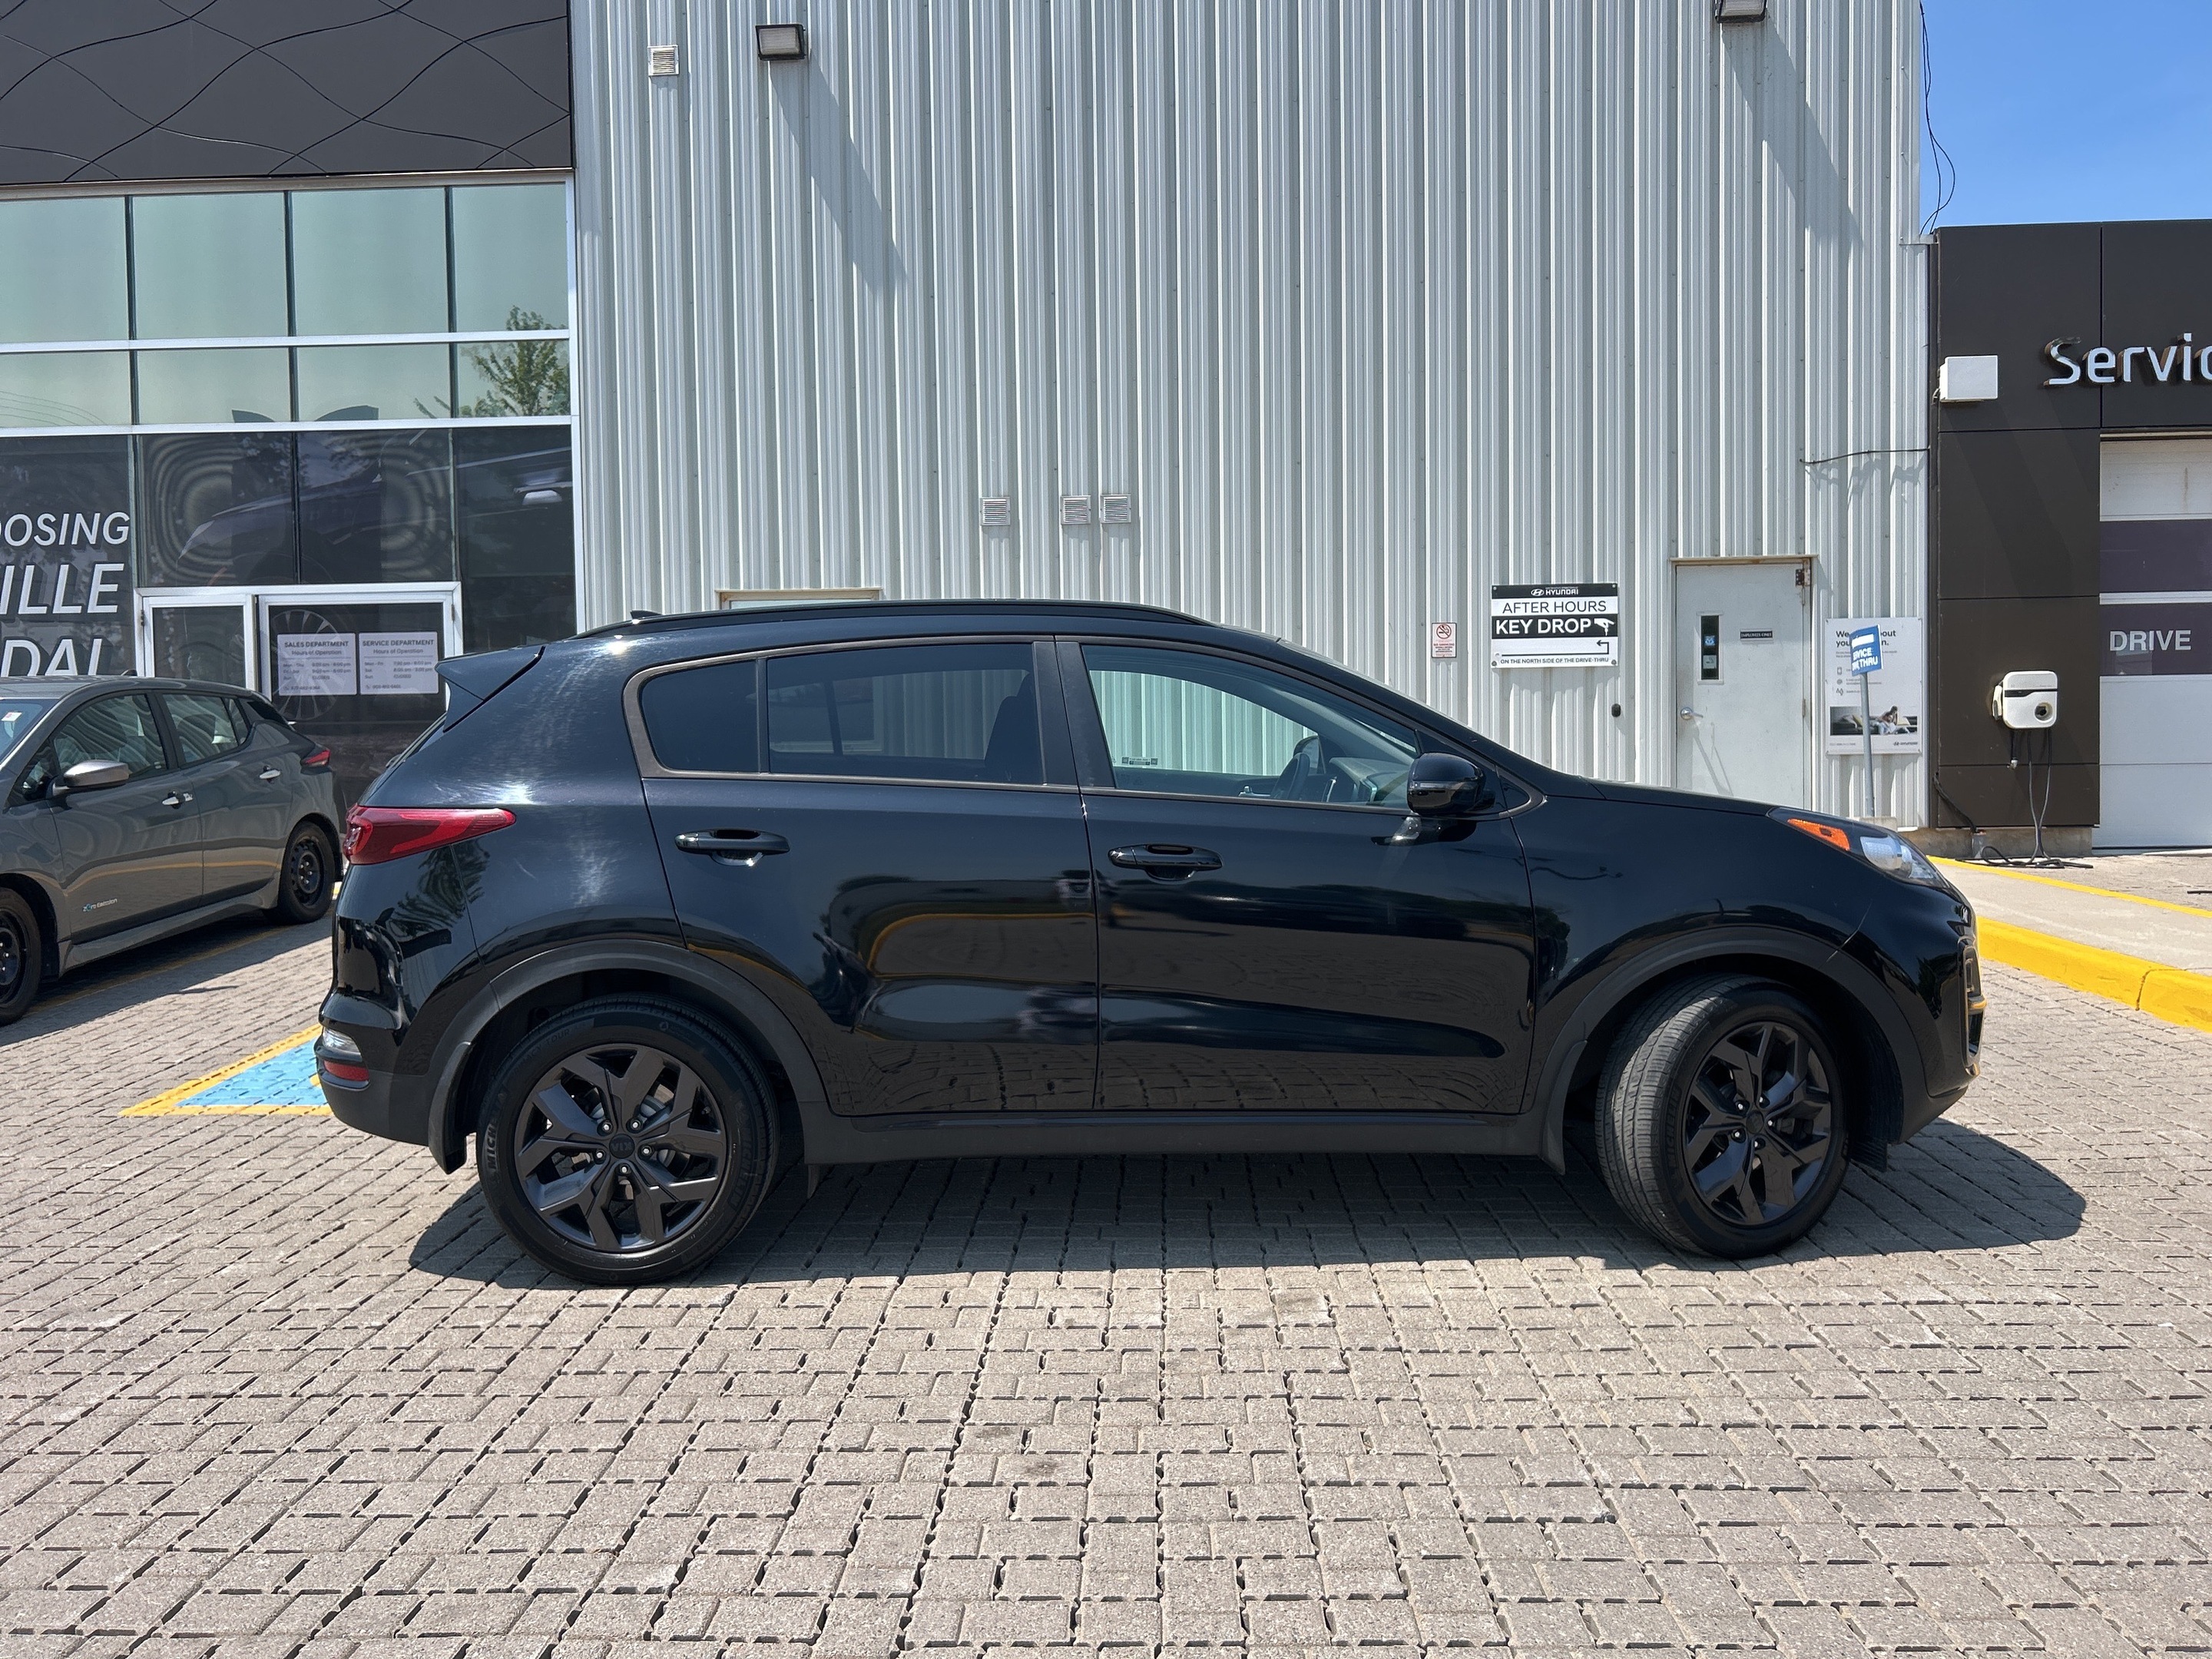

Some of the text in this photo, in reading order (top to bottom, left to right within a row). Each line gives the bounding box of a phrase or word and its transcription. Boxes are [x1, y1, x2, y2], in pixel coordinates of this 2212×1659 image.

[0, 512, 130, 546] OSING
[1502, 601, 1607, 614] AFTER HOURS
[1495, 618, 1591, 634] KEY DROP
[2110, 630, 2191, 651] DRIVE
[1859, 656, 1879, 668] THRU
